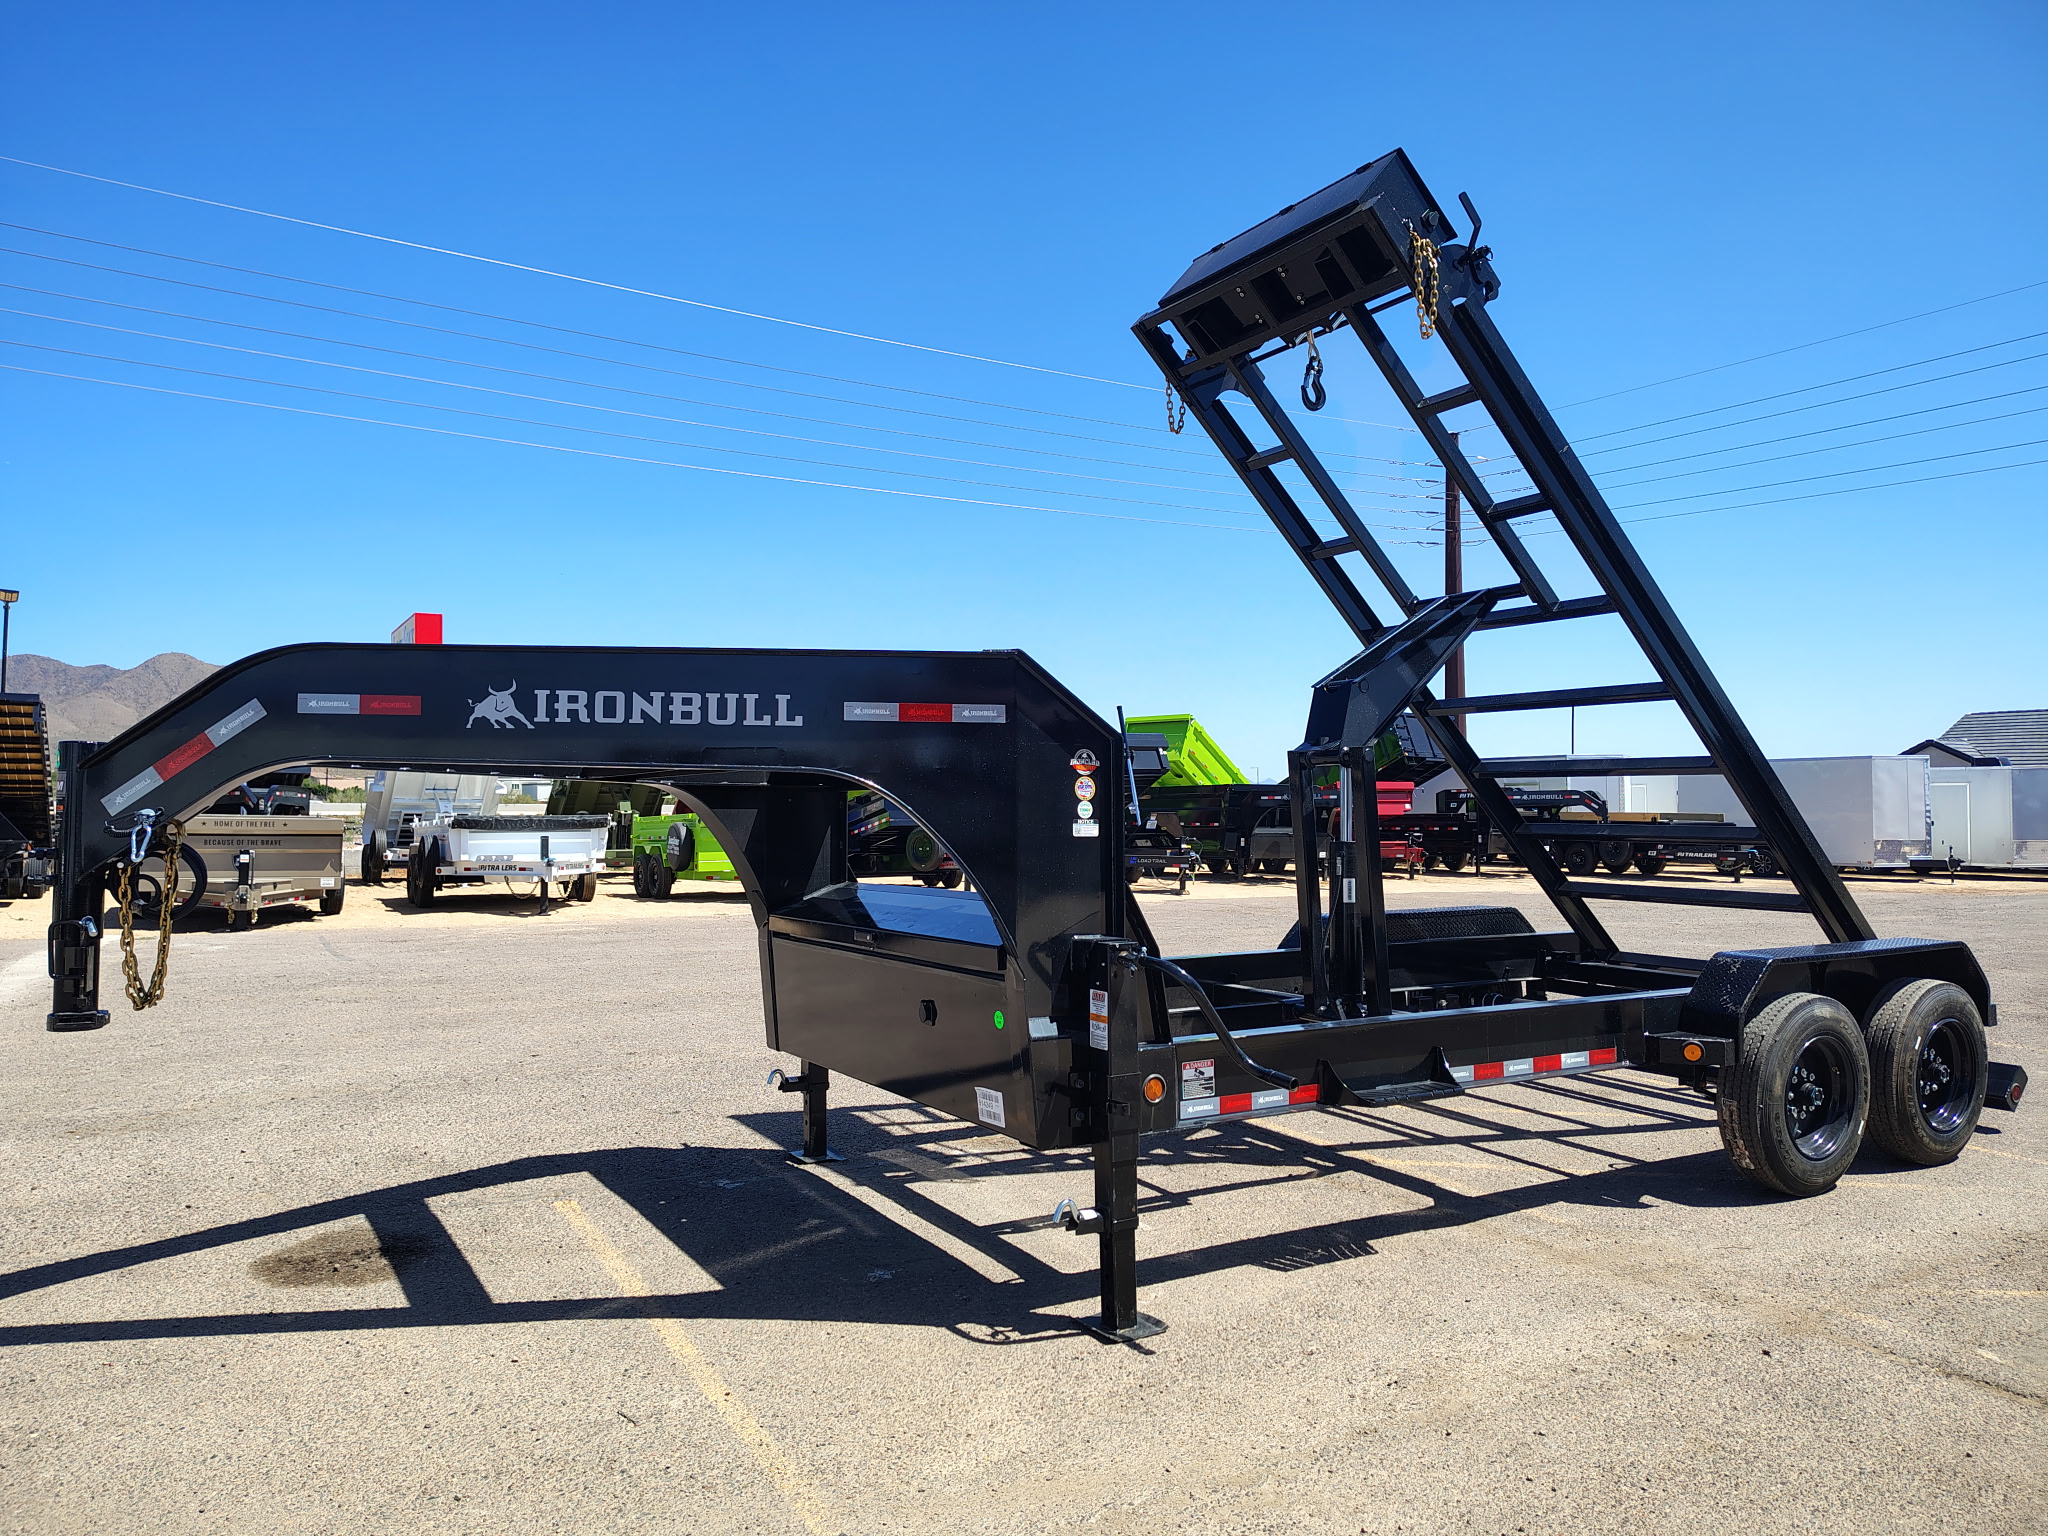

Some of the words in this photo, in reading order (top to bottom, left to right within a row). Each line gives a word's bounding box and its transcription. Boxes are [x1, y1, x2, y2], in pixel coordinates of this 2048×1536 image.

[318, 700, 350, 708] IRONBULL
[533, 689, 804, 727] IRONBULL
[213, 820, 234, 828] HOME
[1191, 1060, 1211, 1069] DANGER
